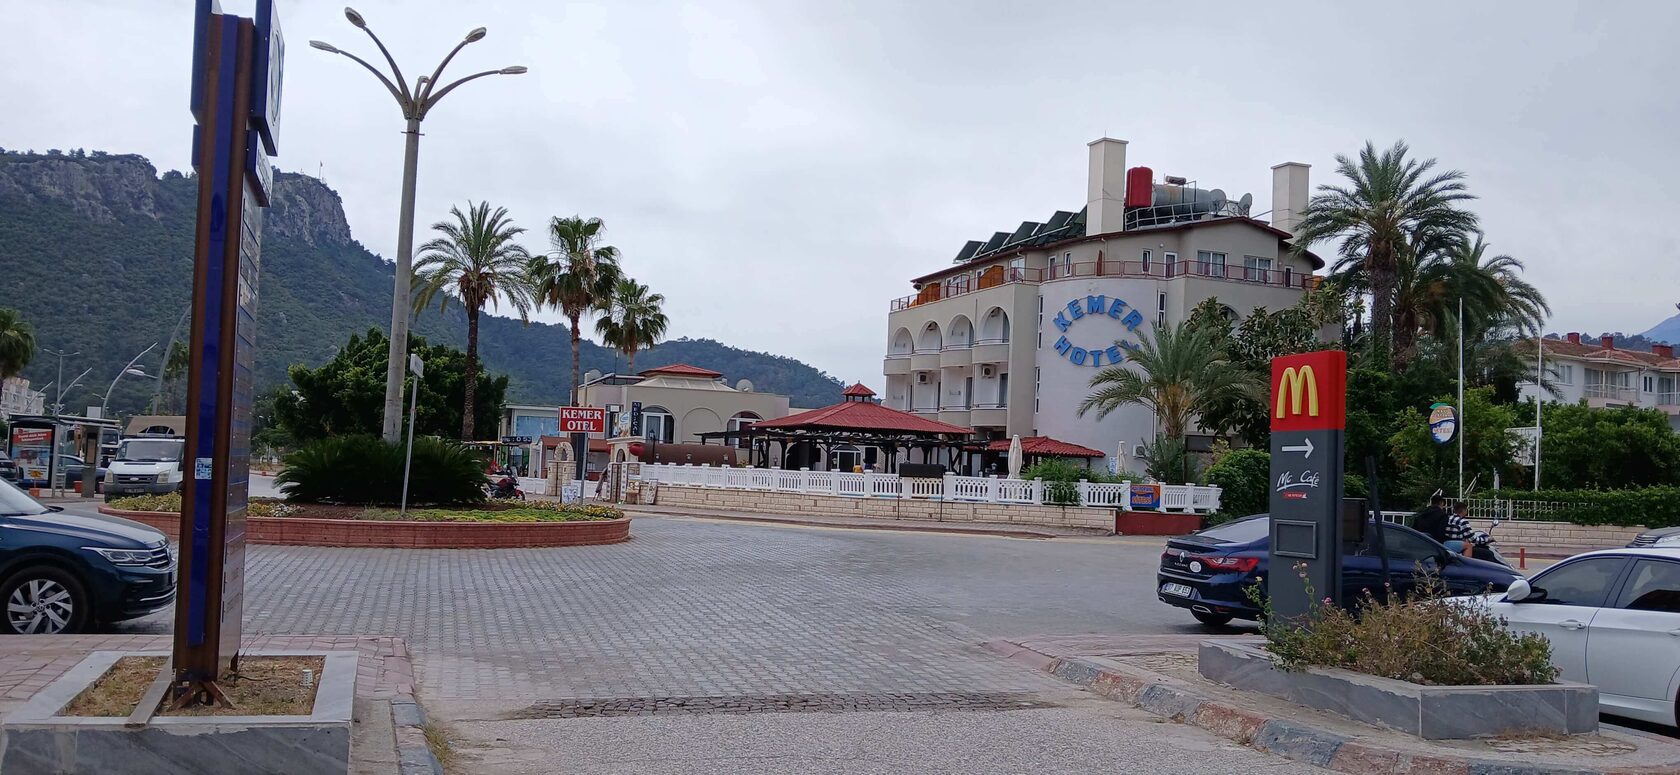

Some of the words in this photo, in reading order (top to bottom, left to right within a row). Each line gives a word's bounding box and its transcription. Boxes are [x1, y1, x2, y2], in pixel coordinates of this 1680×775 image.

[1053, 295, 1143, 332] KEMER
[562, 409, 602, 420] KEMER
[567, 420, 597, 431] OTEL
[1276, 471, 1292, 487] Mc
[1300, 469, 1320, 487] Café
